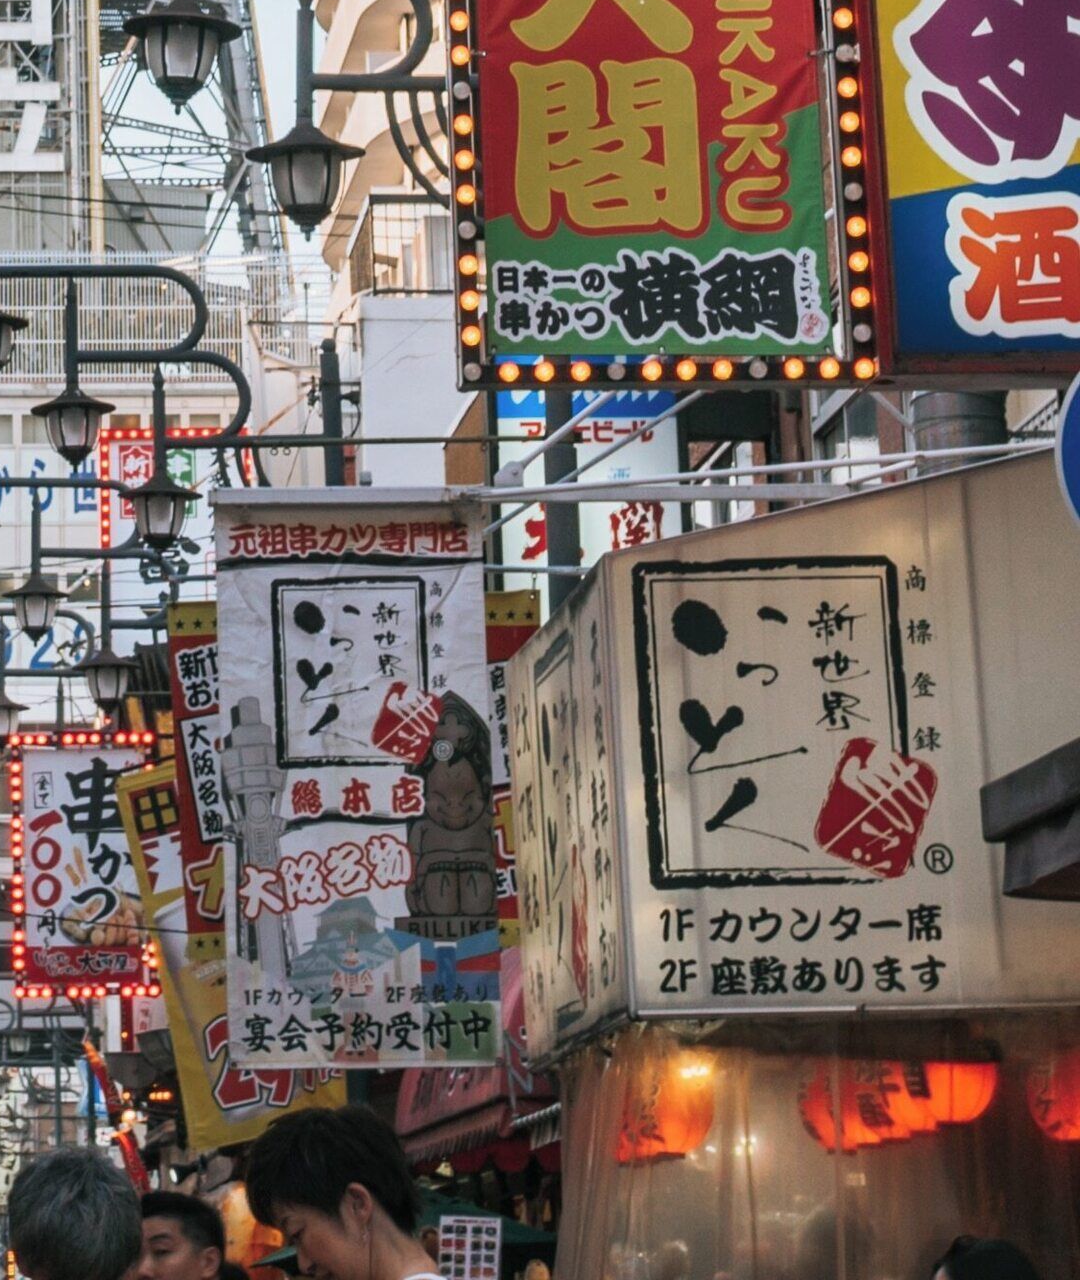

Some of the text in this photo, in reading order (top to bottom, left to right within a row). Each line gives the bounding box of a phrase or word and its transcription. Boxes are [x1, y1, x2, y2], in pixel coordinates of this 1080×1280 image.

[497, 266, 605, 293] 日本一の
[608, 252, 796, 339] 横綱
[499, 301, 605, 336] 串かつ
[229, 521, 469, 557] 元祖串カツ専門店
[371, 601, 408, 677] 新世界
[808, 601, 870, 731] 新世界
[905, 565, 941, 752] 商標登録
[188, 723, 224, 835] 大阪名物
[292, 777, 422, 815] 総本店
[61, 757, 133, 923] 串かつ
[239, 834, 414, 919] 大阪名物
[659, 903, 943, 942] 1F カウンター席
[659, 955, 946, 996] 2F 座敷あります
[241, 1009, 492, 1053] 宴会予約受付中
